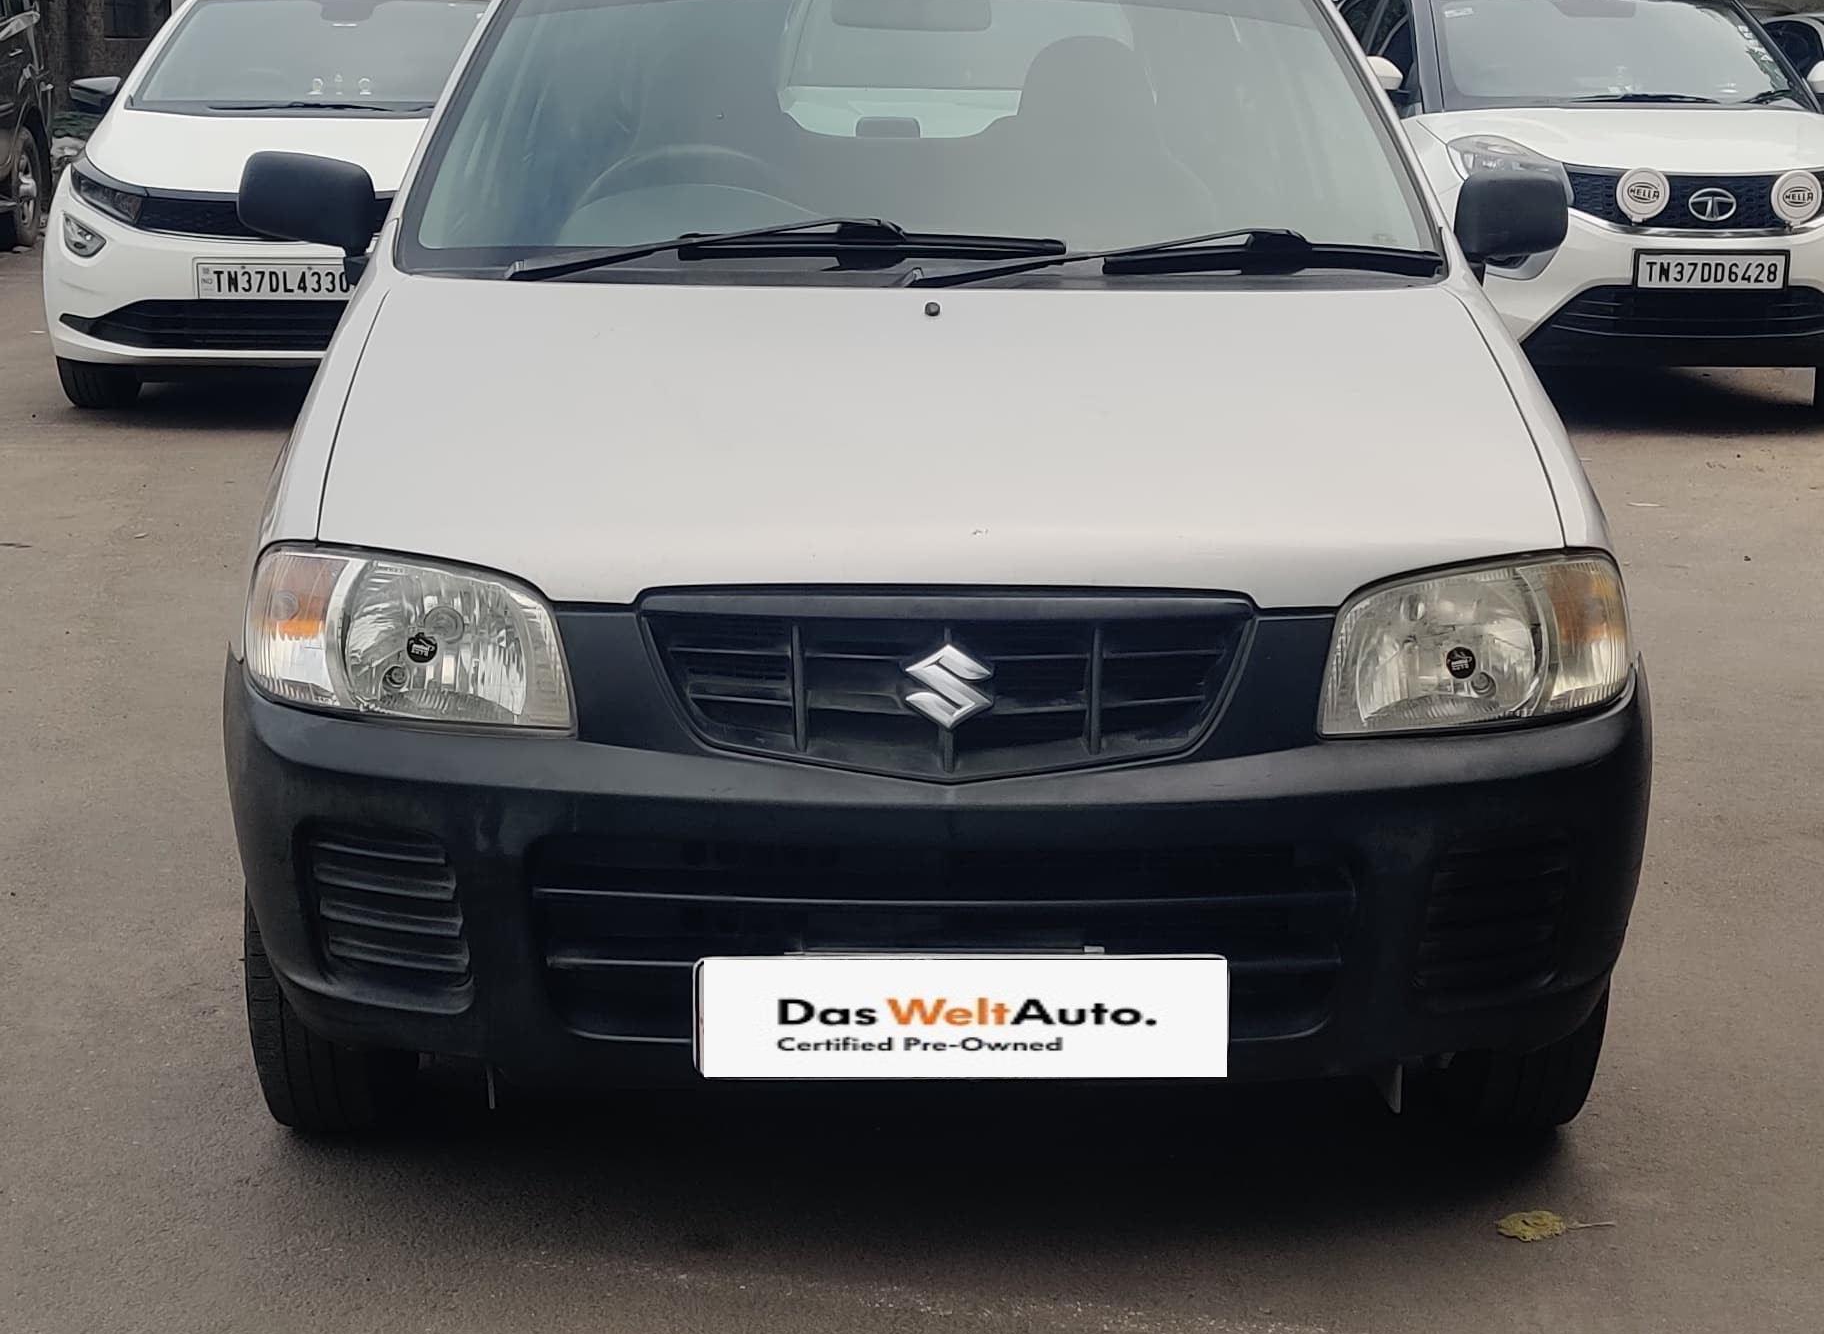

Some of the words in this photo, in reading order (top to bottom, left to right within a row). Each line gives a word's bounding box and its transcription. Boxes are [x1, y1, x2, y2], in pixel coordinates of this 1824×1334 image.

[1629, 186, 1660, 200] HELLA
[1785, 189, 1814, 201] HELLA
[1646, 262, 1778, 283] TN37DD6428
[213, 270, 350, 293] TN37DL4330
